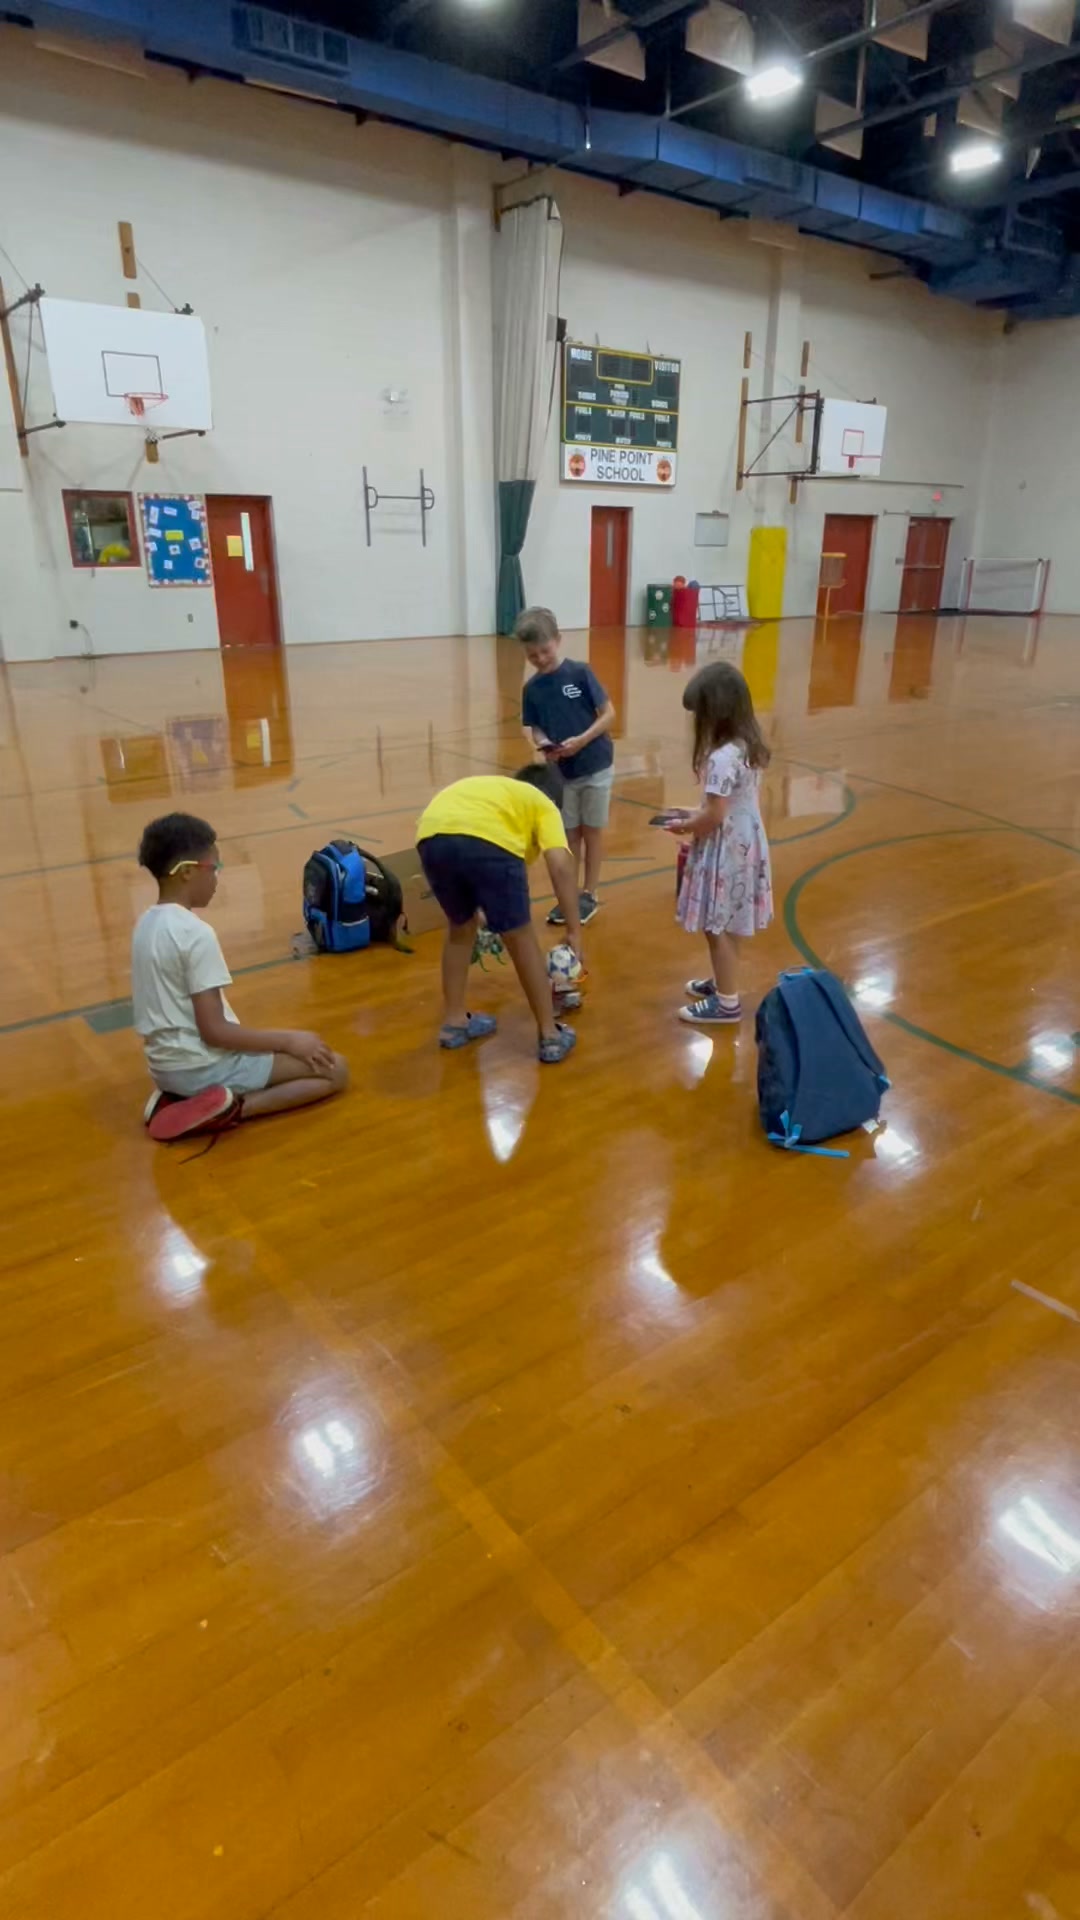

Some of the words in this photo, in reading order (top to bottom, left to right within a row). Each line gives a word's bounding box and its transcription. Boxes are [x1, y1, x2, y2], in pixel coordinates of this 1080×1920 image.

[590, 448, 616, 463] PINE
[620, 451, 653, 465] POINT
[597, 466, 645, 481] SCHOOL
